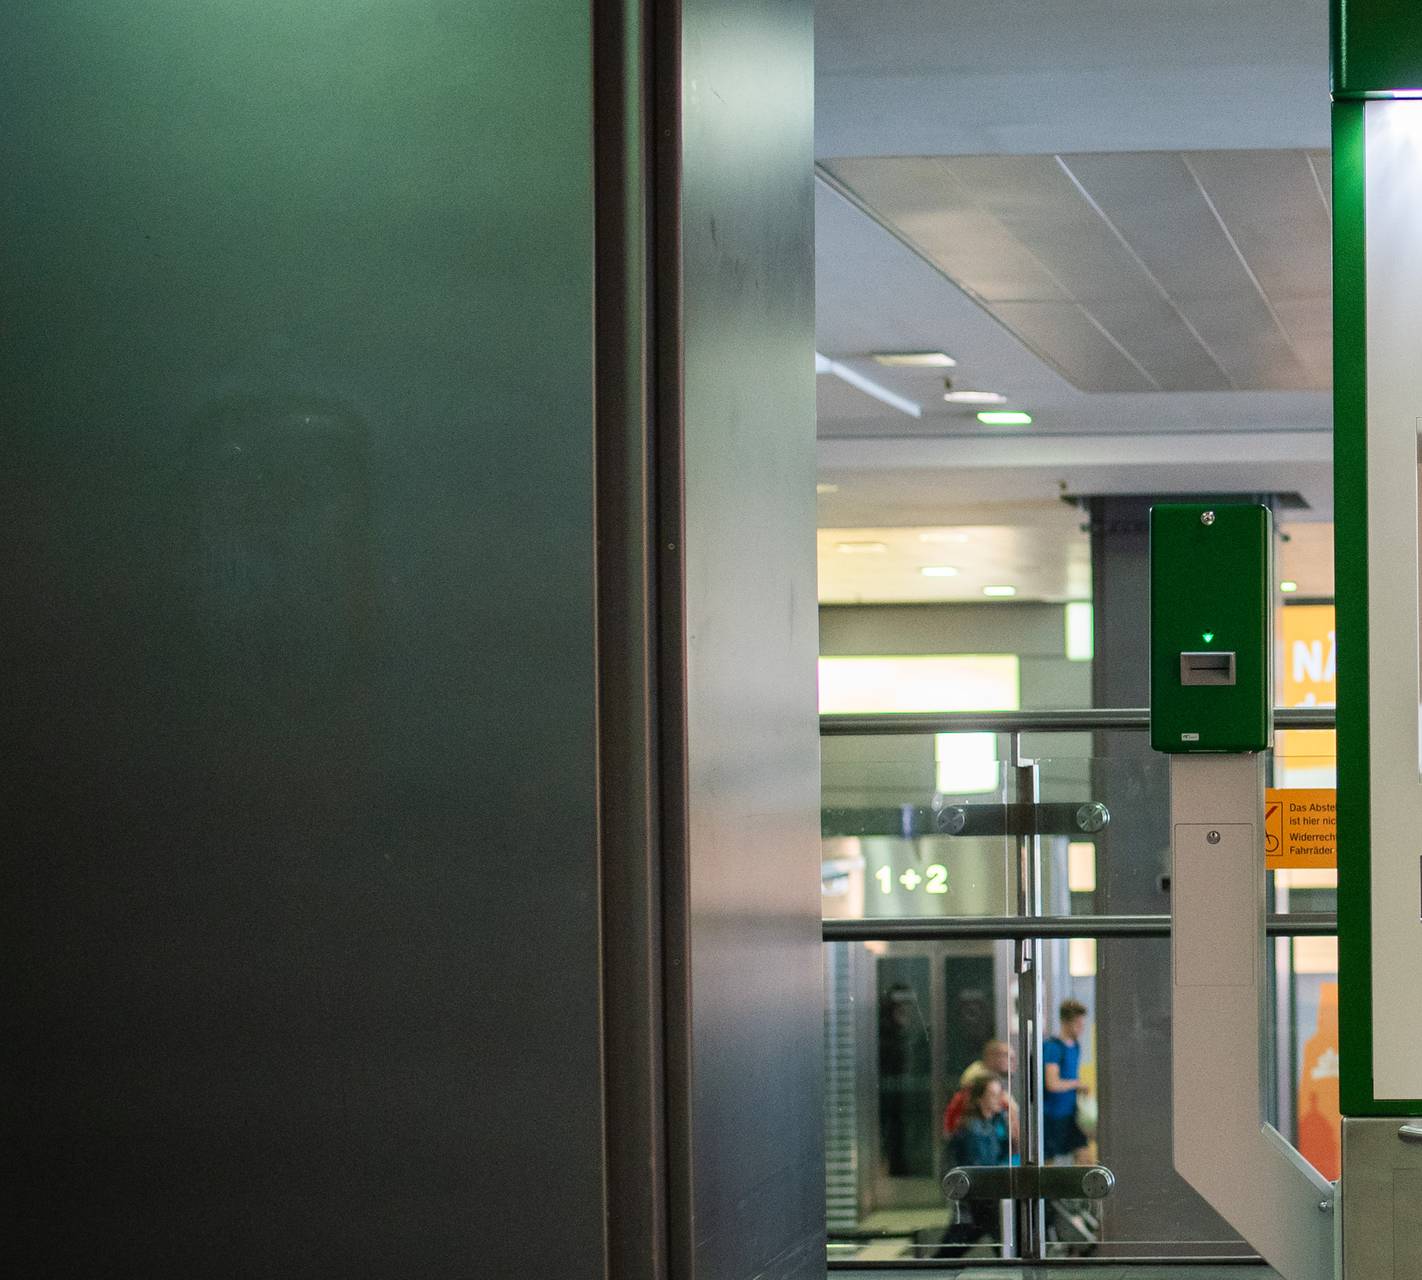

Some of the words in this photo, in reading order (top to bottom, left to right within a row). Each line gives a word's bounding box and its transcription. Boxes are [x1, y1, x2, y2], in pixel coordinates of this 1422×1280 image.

[1290, 803, 1307, 812] Das
[1290, 816, 1302, 825] ist
[1303, 816, 1320, 825] hier
[1290, 846, 1334, 855] Fahrräder
